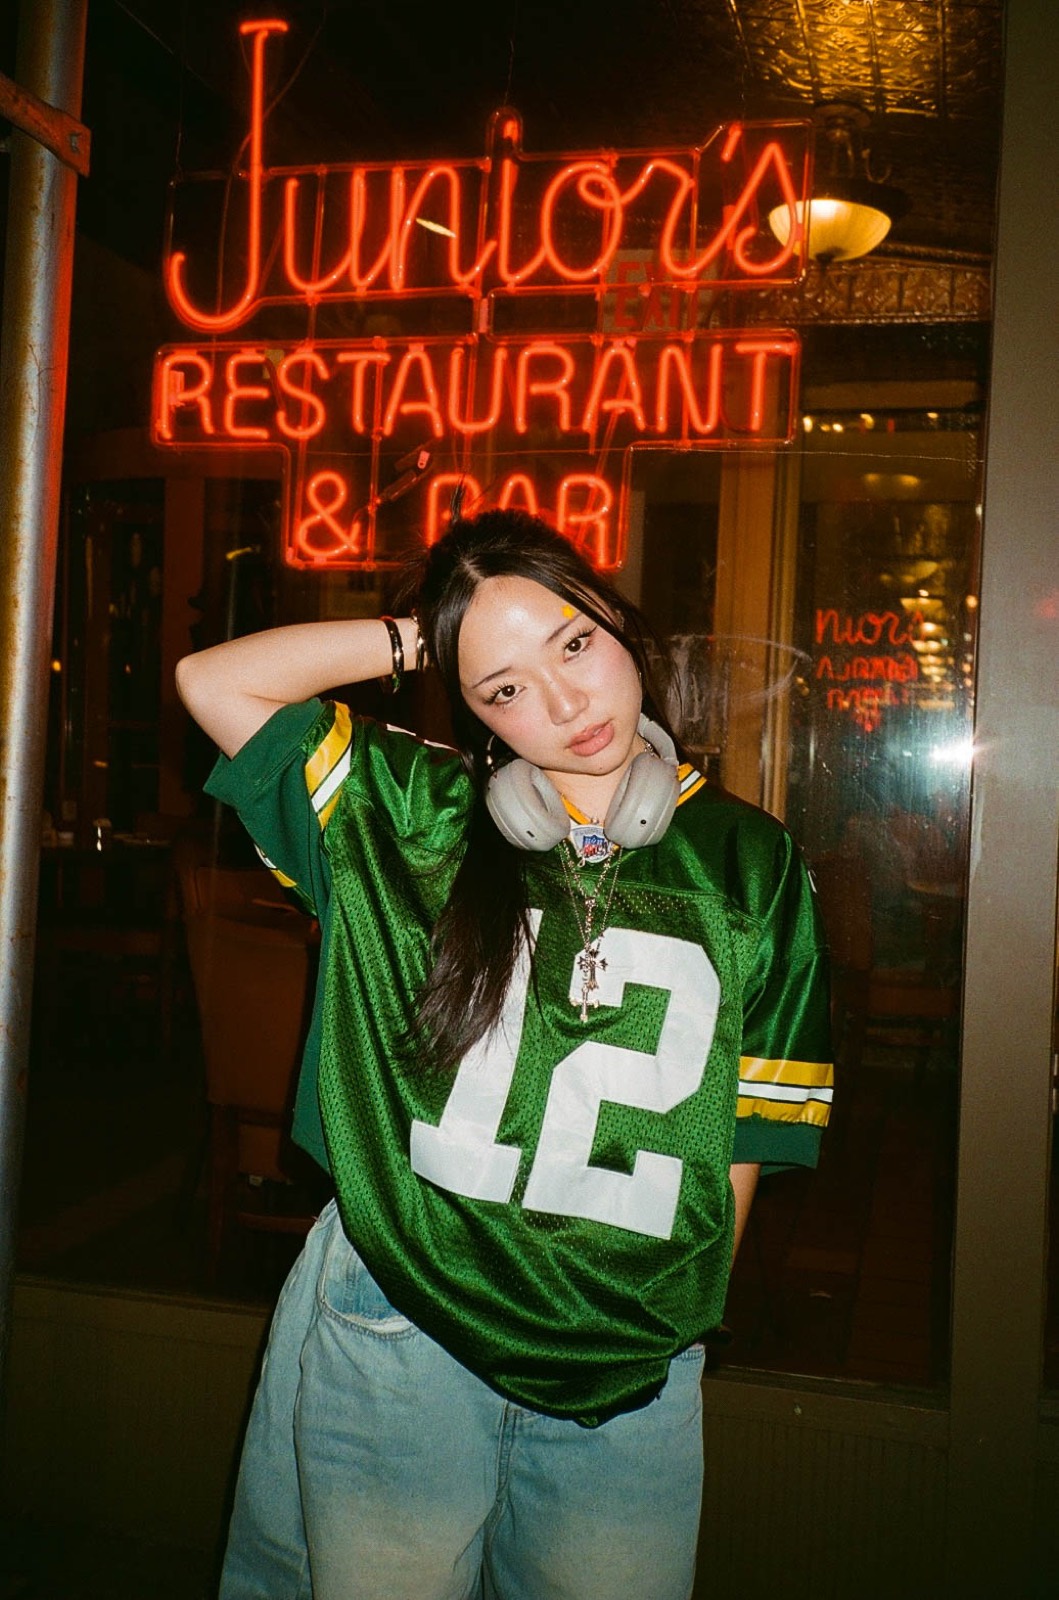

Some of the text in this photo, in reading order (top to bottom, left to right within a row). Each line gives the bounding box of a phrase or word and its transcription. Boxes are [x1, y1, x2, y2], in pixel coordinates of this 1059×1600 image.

[168, 20, 800, 332] Junior's
[159, 341, 799, 440] RESTAURANT
[299, 470, 361, 557] &
[409, 907, 722, 1240] 12
